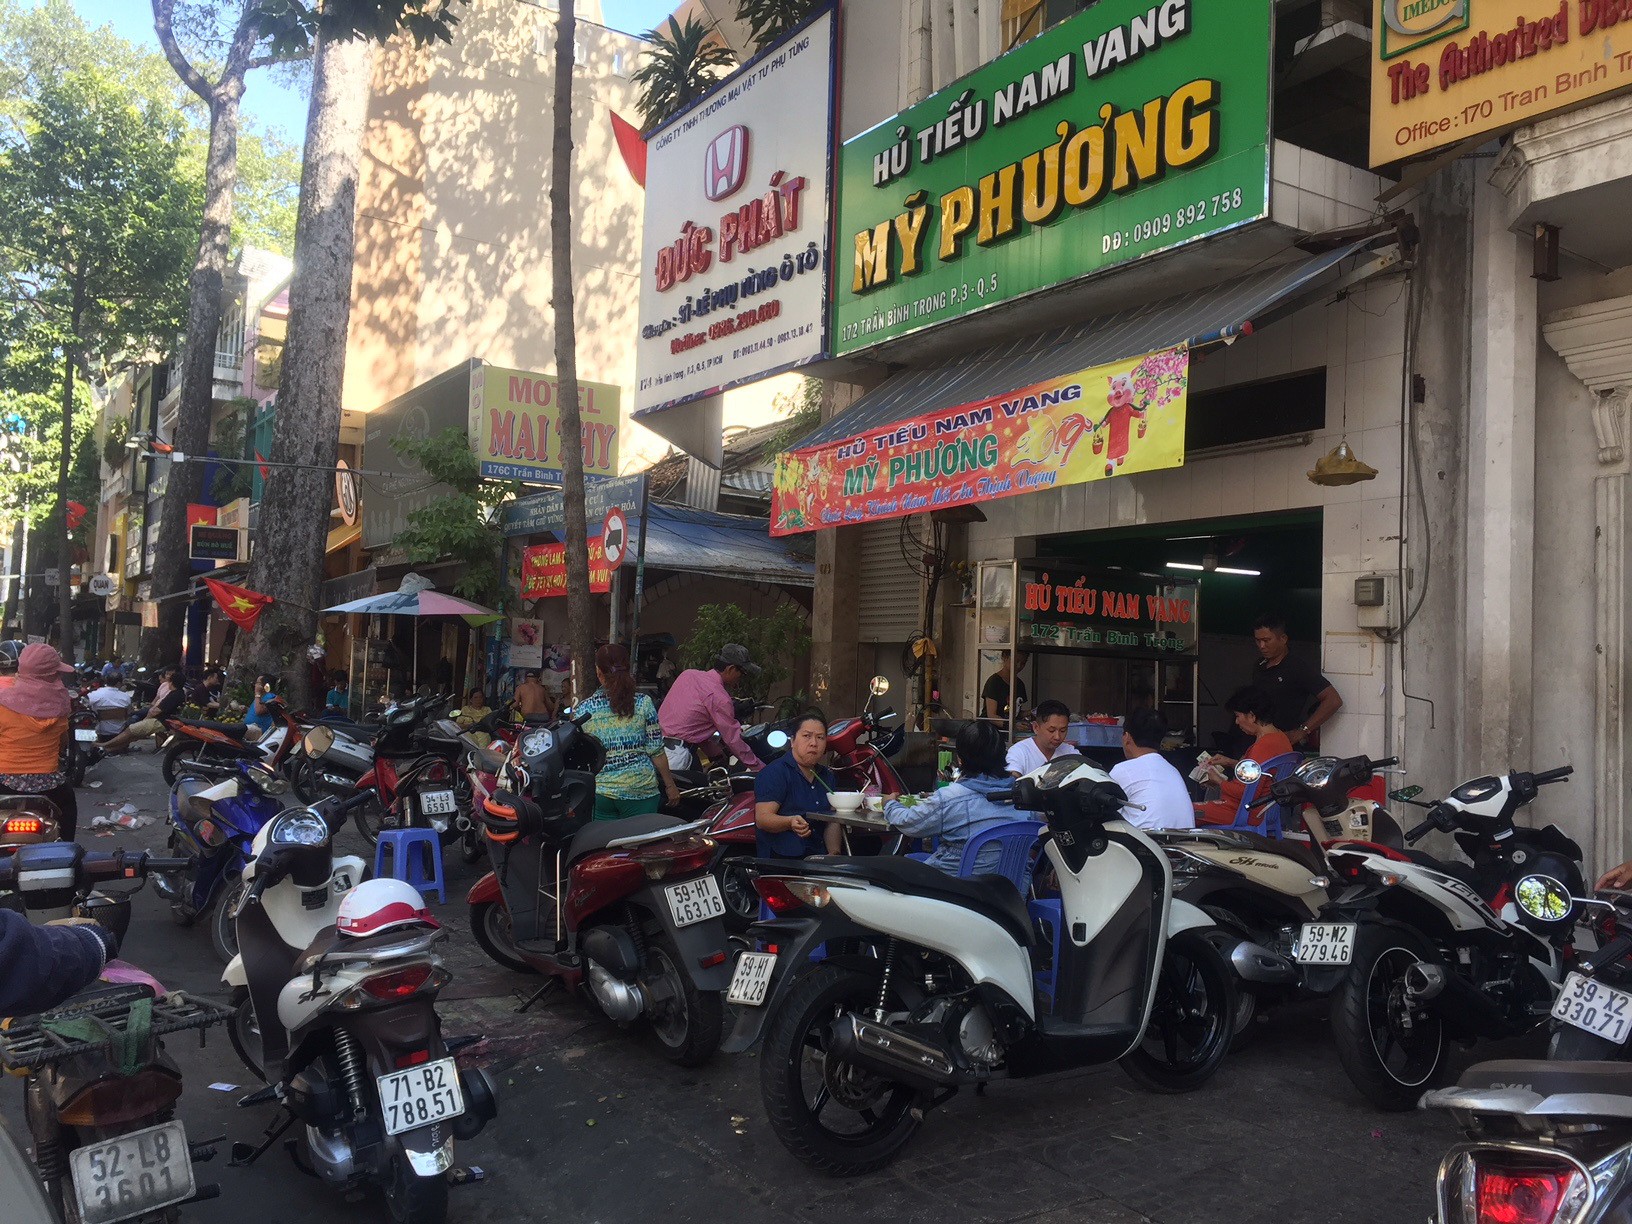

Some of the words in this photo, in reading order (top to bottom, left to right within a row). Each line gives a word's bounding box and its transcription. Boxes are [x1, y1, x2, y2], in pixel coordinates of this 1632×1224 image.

[1387, 60, 1430, 105] The
[1439, 1, 1569, 92] Authorized
[673, 126, 681, 140] TY
[683, 115, 698, 132] TNHH
[728, 85, 741, 101] MẠI
[742, 74, 757, 91] VẬT
[759, 65, 770, 80] TƯ
[771, 54, 786, 72] PHỤ
[789, 36, 809, 60] TÙNG
[873, 126, 908, 186] HỦ
[917, 89, 983, 161] TIẾU
[993, 53, 1074, 124] NAM
[1083, 0, 1188, 77] VANG
[1498, 84, 1547, 112] Tran
[1555, 62, 1607, 95] Binh
[851, 190, 928, 293] MỸ
[939, 79, 1215, 261] PHƯƠNG
[655, 220, 713, 292] ĐỨC
[719, 170, 806, 263] PHÁT
[1133, 213, 1171, 243] 0909
[1175, 201, 1206, 230] 892
[1211, 187, 1243, 217] 758
[710, 282, 738, 311] PHỤ
[780, 253, 794, 281] Ô
[796, 241, 819, 274] TÔ
[842, 321, 858, 342] 172
[860, 308, 886, 337] TRẦN
[886, 301, 910, 329] BÌNH
[913, 293, 947, 321] TRỌNG
[489, 408, 550, 462] MAI
[837, 435, 864, 460] HỦ
[873, 422, 927, 450] TIẾU
[936, 407, 993, 435] NAM
[999, 384, 1082, 419] VANG
[487, 464, 510, 475] 176C
[535, 468, 554, 480] Bình
[843, 455, 879, 497] MỸ
[888, 435, 998, 487] PHƯƠNG
[865, 498, 898, 517] Khách
[901, 492, 928, 510] Năm
[929, 486, 952, 506] Mới
[977, 475, 1013, 499] Thịnh
[1015, 469, 1057, 489] Vượng
[1025, 572, 1051, 611] HỦ
[1056, 575, 1097, 615] TIẾU
[1101, 590, 1140, 619] NAM
[1146, 595, 1190, 623] VANG
[1031, 624, 1060, 639] 172
[1067, 627, 1101, 643] Trần
[1106, 630, 1139, 646] Bình
[1144, 633, 1184, 651] Trọng
[427, 802, 451, 813] 6591
[674, 879, 710, 904] 59-H1
[675, 896, 721, 923] 463.16
[1300, 944, 1349, 961] 279.46
[1309, 926, 1347, 943] 59-M2
[740, 957, 770, 978] 59-H1
[1558, 997, 1625, 1038] 330.71
[1573, 981, 1629, 1016] 59-X2
[390, 1066, 446, 1101] 71-B2
[388, 1089, 456, 1129] 788.51
[89, 1131, 171, 1181] 52-L8
